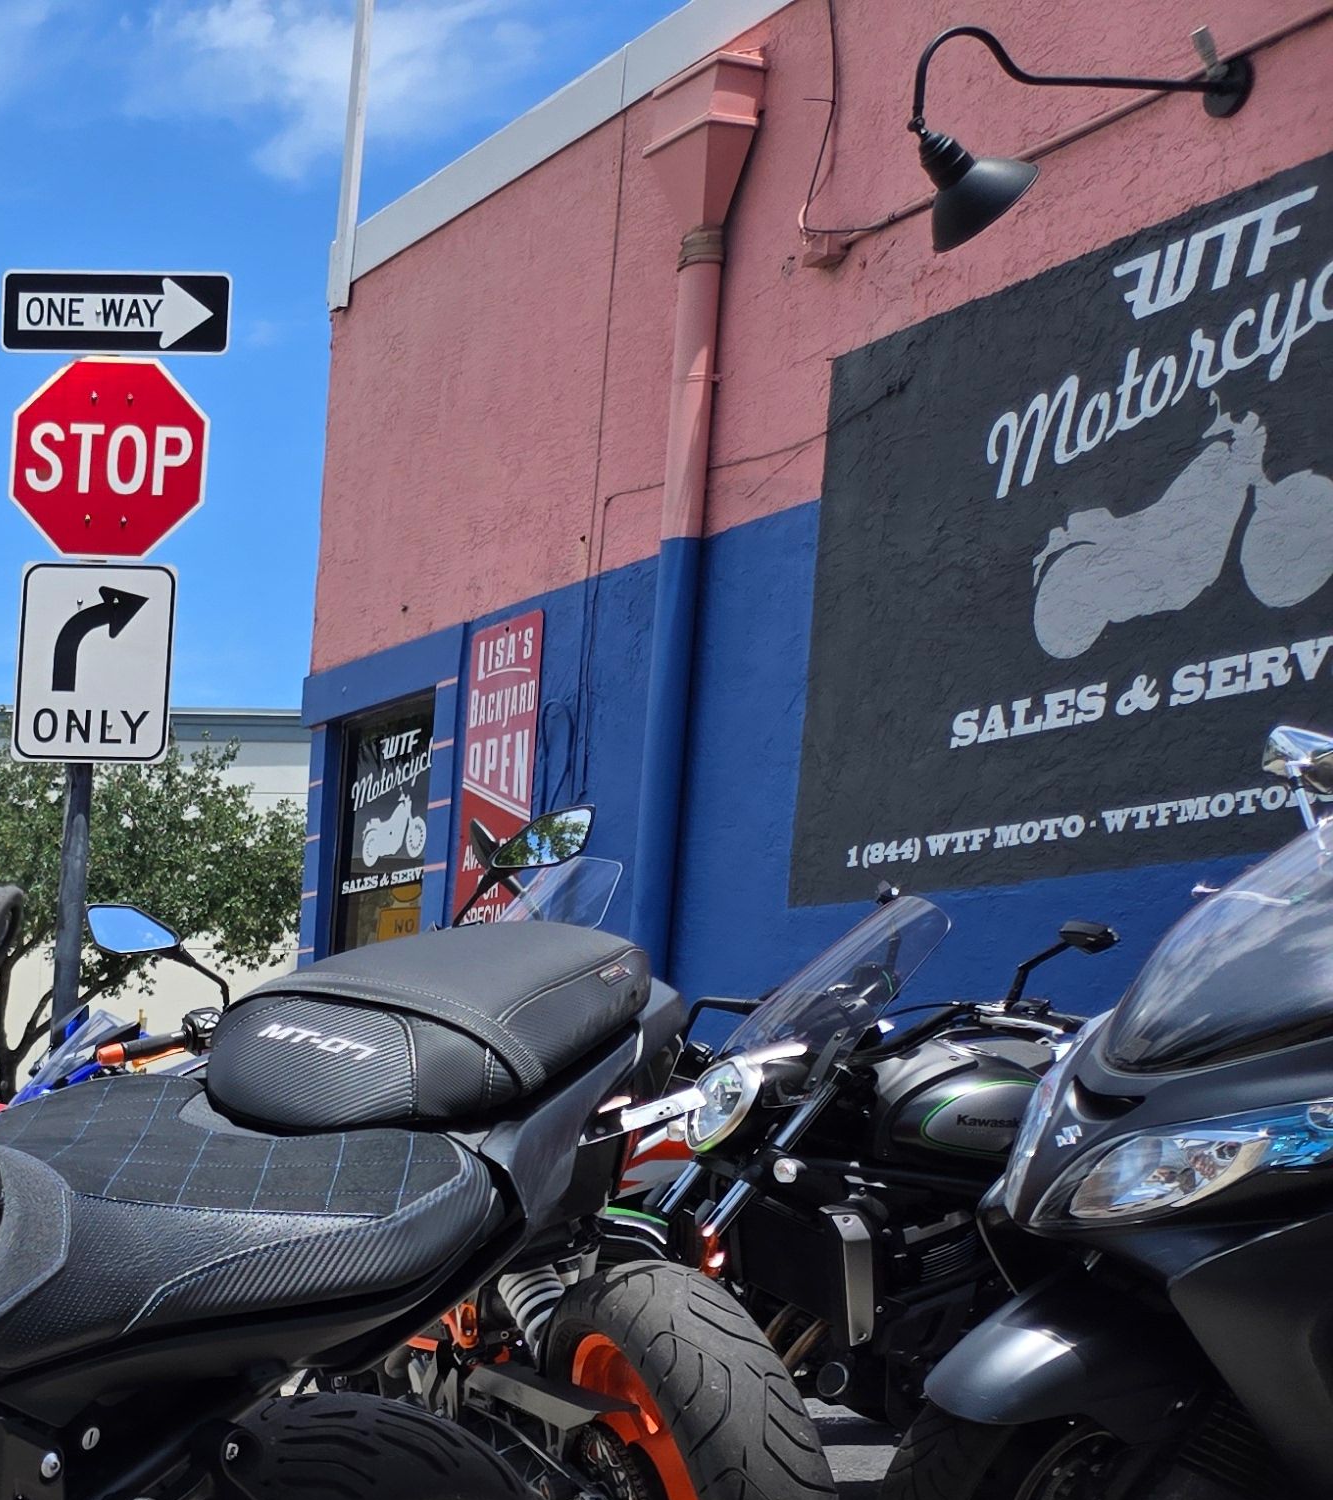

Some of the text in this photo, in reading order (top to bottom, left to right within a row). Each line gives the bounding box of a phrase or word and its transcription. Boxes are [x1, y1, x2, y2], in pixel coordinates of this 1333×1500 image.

[1113, 185, 1319, 320] WTF
[25, 297, 163, 328] ONE WAY
[25, 422, 194, 496] STOP
[477, 627, 534, 681] LISA'S
[32, 708, 150, 745] ONLY
[949, 681, 1109, 749] SALES
[1115, 674, 1160, 716] &
[380, 728, 422, 760] WTF
[468, 728, 529, 803] OPEN
[846, 846, 859, 868] 1
[862, 837, 921, 869] (844)
[926, 828, 990, 857] WTF
[993, 815, 1086, 849] MOTO
[341, 874, 379, 895] SALES
[380, 872, 390, 887] &
[393, 918, 415, 934] NO
[257, 1023, 378, 1061] MT-07
[956, 1114, 1023, 1129] Kawasak
